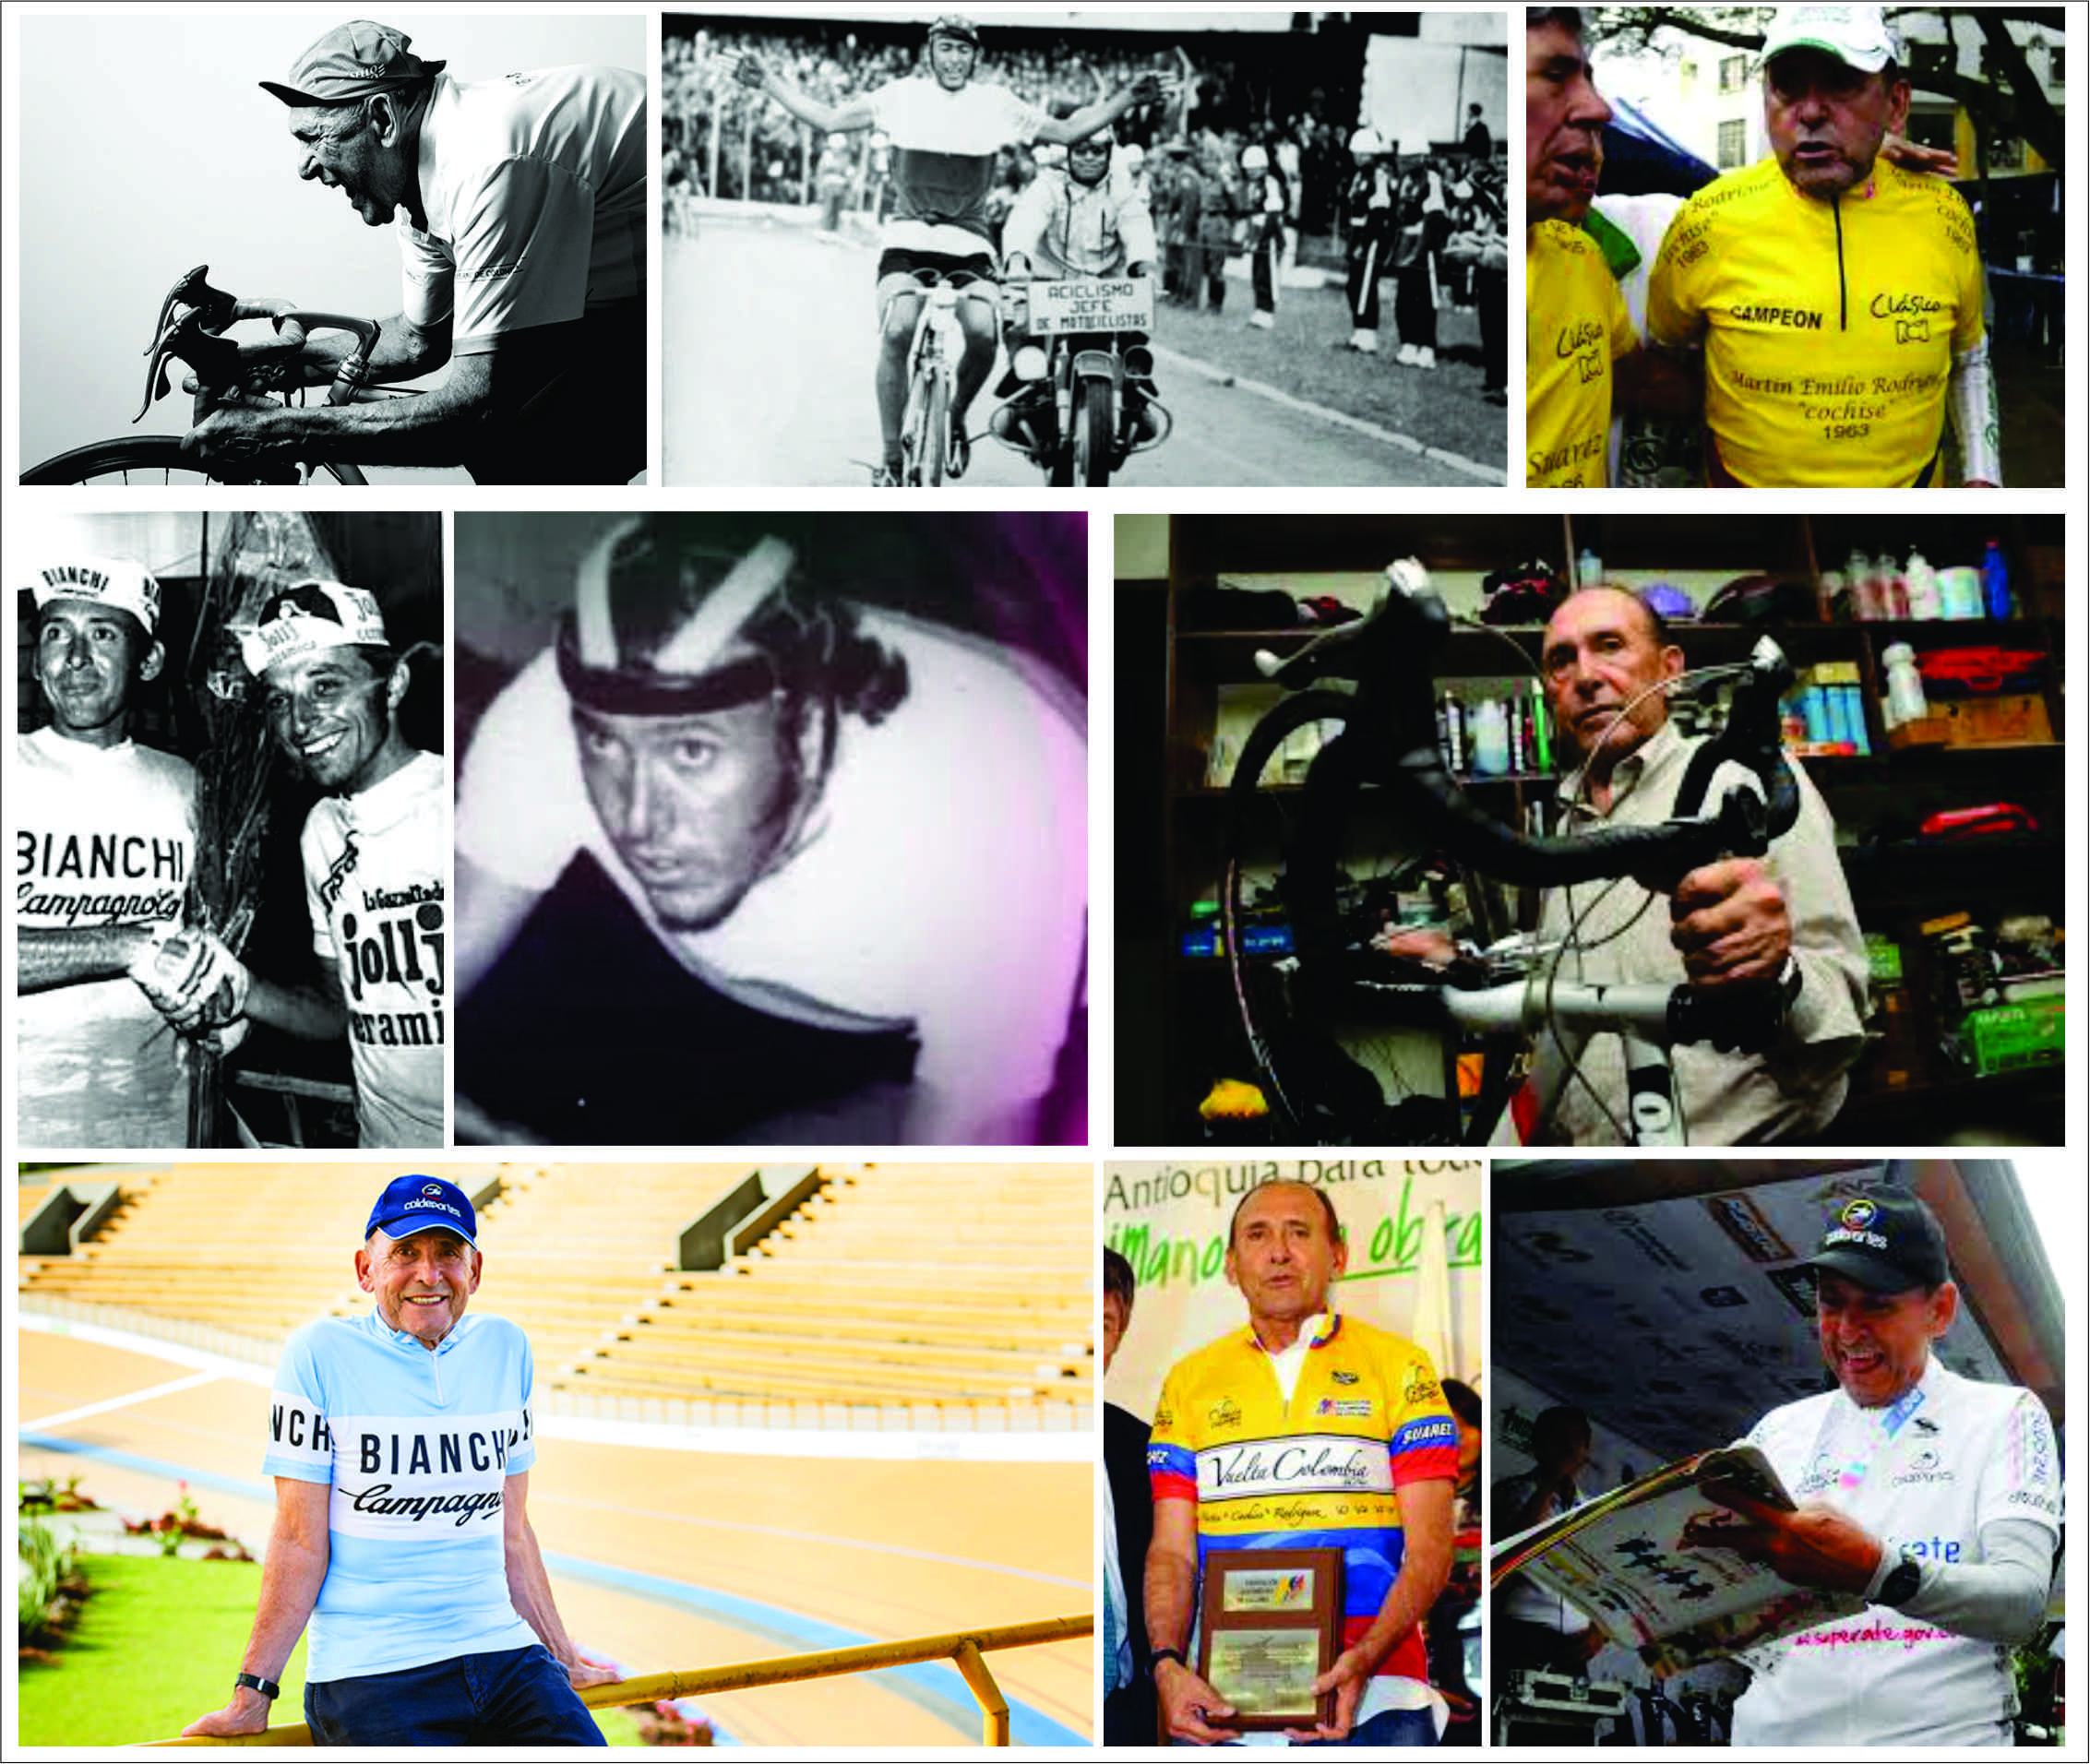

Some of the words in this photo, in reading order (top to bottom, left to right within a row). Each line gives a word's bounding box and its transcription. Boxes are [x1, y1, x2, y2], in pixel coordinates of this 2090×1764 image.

[1048, 283, 1133, 298] ACICLISMO
[1070, 300, 1113, 314] JEFE
[1729, 304, 1824, 330] CAMPEON
[1036, 317, 1050, 330] DE
[1060, 314, 1147, 329] MOTOCICLISTAS
[1798, 375, 1866, 397] Emilio
[1822, 422, 1870, 440] 1963
[42, 566, 110, 592] BIANCHI
[18, 831, 185, 883] BIANCHI
[1104, 1161, 1279, 1211] Antioquia
[404, 1198, 462, 1218] coldeportes
[1209, 1447, 1270, 1487] Vuelta
[1272, 1447, 1369, 1481] Colombia
